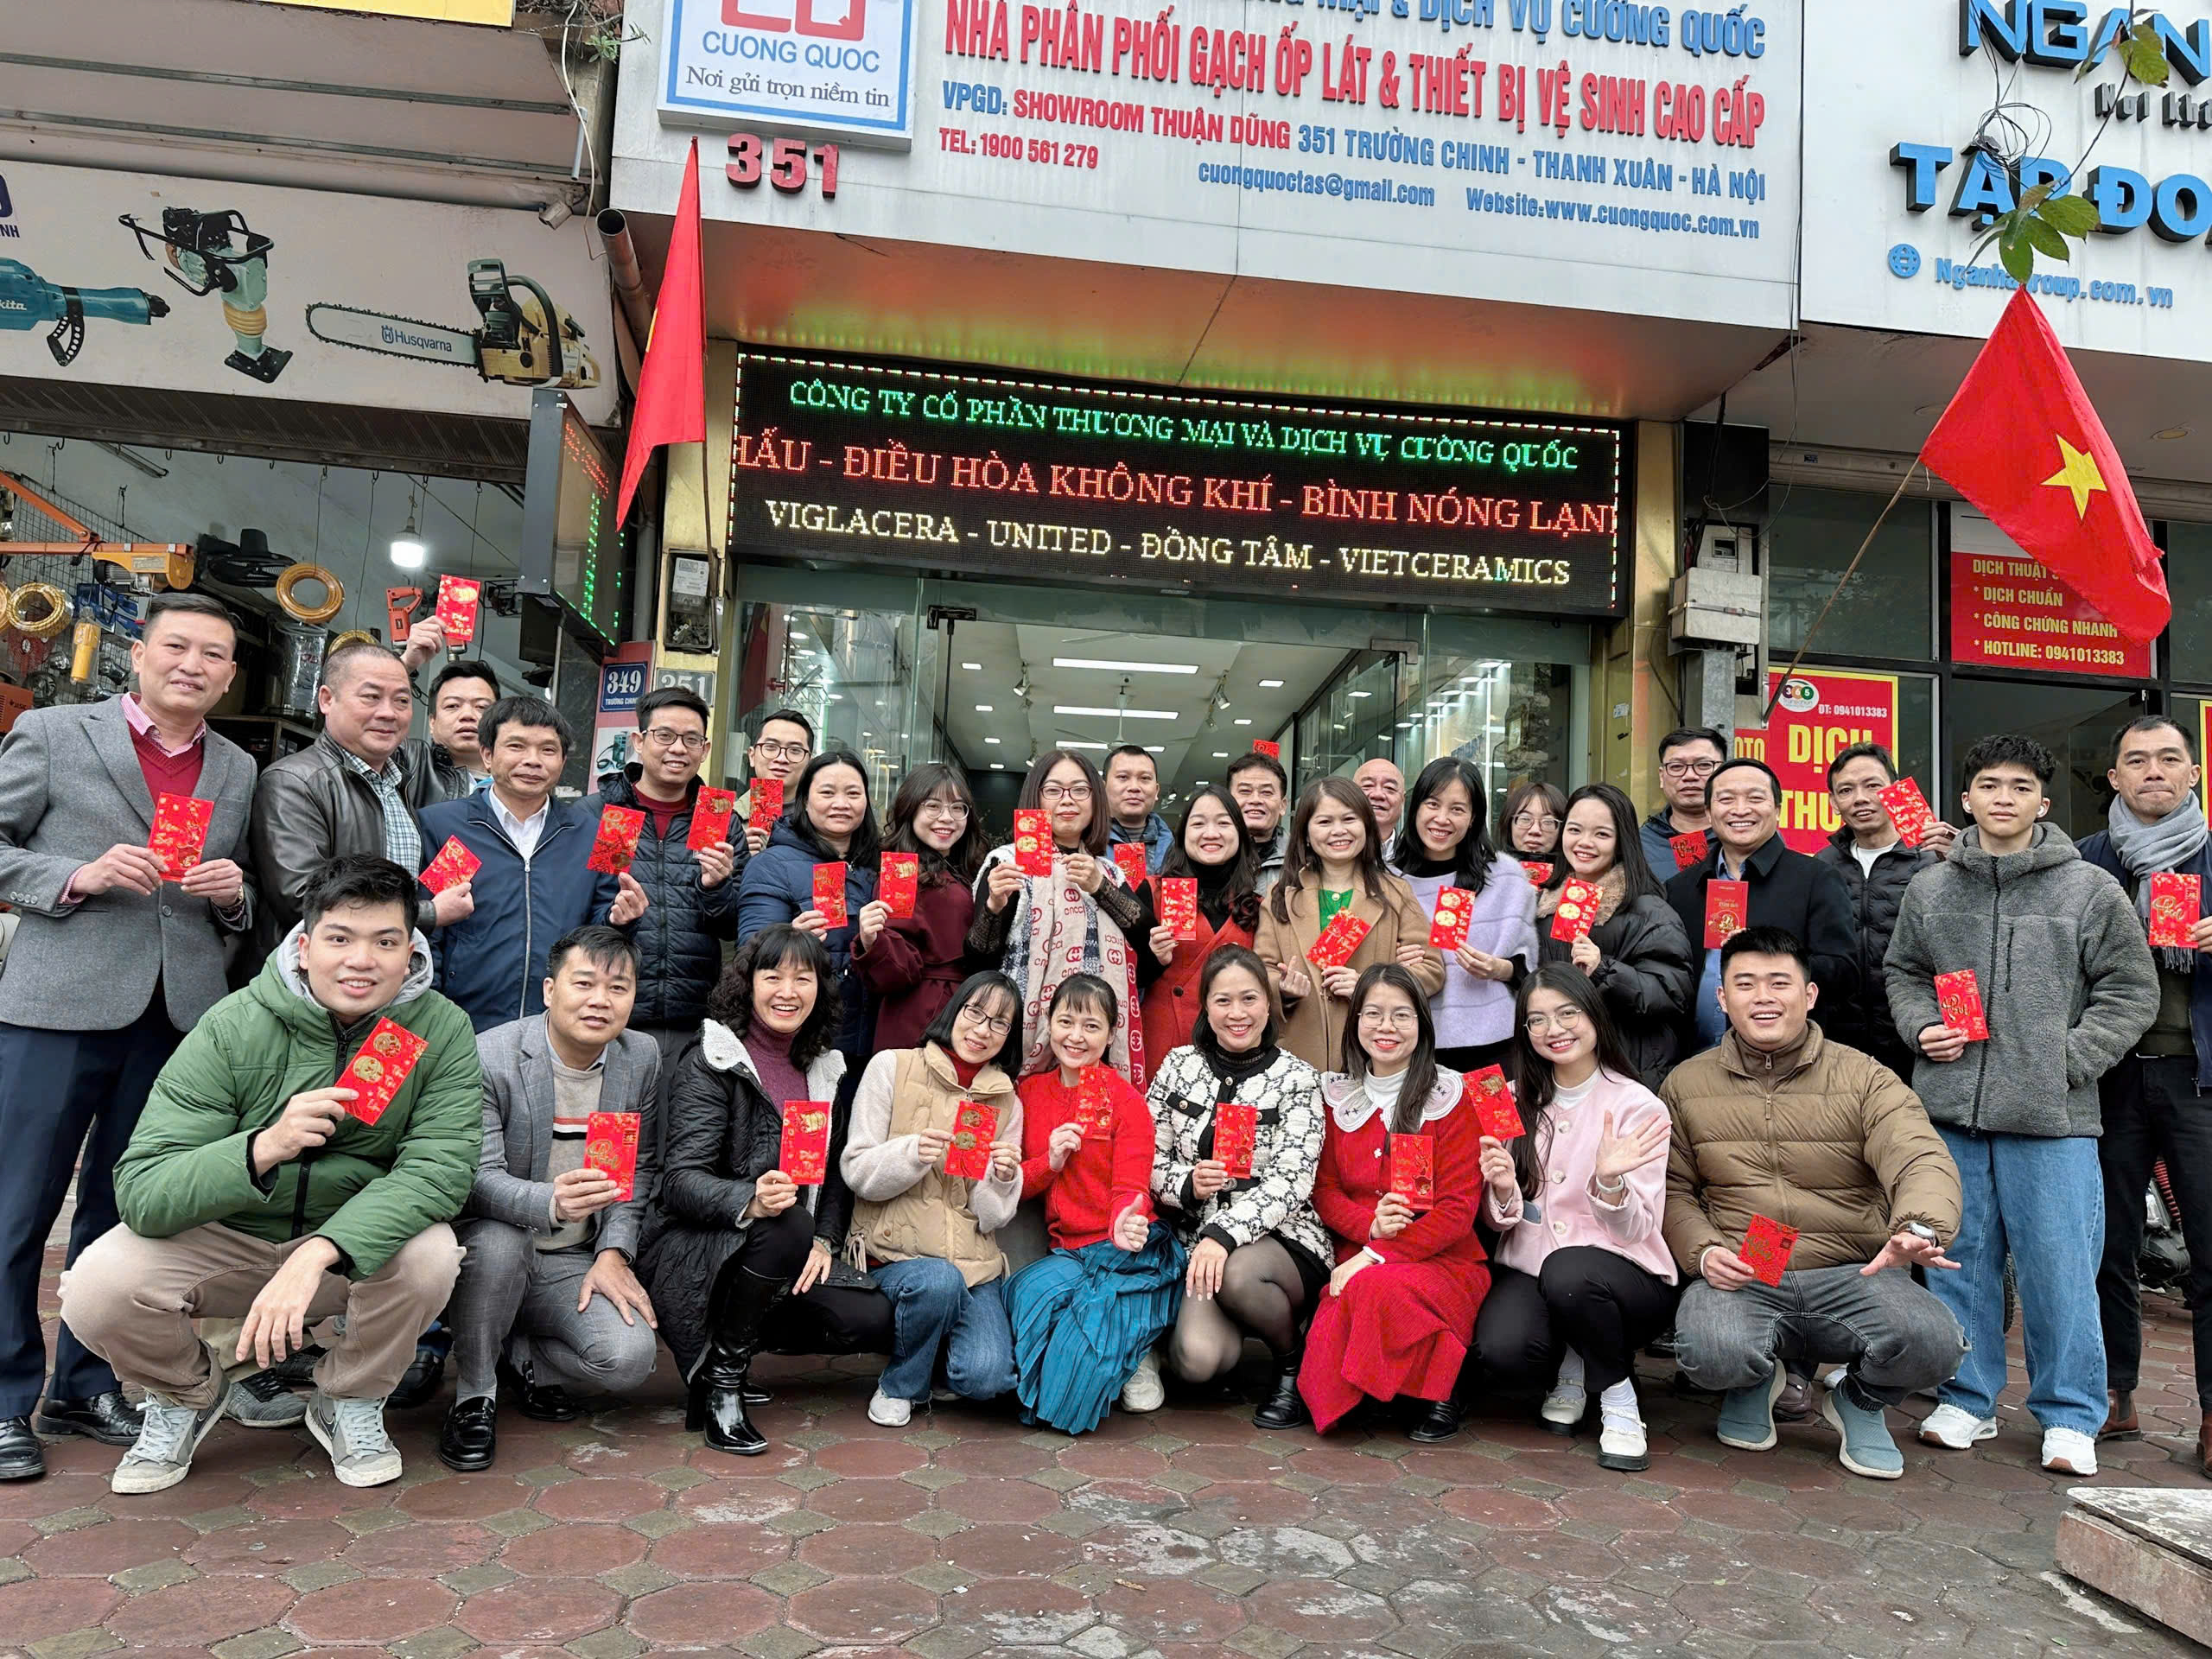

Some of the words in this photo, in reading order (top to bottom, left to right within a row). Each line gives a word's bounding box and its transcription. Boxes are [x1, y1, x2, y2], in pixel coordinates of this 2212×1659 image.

[1511, 0, 1551, 44] VỤ
[1681, 3, 1764, 58] QUỐC
[702, 31, 797, 63] CUONG
[805, 44, 880, 73] QUOC
[685, 66, 723, 87] Nơi
[730, 73, 760, 94] gửi
[767, 78, 804, 100] trọn
[810, 82, 858, 103] niềm
[865, 87, 890, 107] tin
[1020, 0, 1104, 73] PHÂN
[1112, 5, 1180, 83] PHỐI
[1189, 26, 1266, 98] GẠCH
[1275, 21, 1313, 97] ỐP
[1322, 34, 1372, 105] LÁT
[1379, 51, 1400, 109] &
[1408, 43, 1486, 118] THIẾT
[1498, 64, 1526, 134] BỊ
[1537, 60, 1570, 138] VỆ
[1580, 73, 1646, 137] SINH
[1655, 81, 1705, 143] CAO
[1712, 75, 1765, 148] CẤP
[939, 127, 976, 155] TEL:
[980, 133, 1022, 159] 1900
[1028, 139, 1058, 164] 561
[1064, 143, 1098, 168] 279
[943, 80, 1007, 116] VPGD:
[1014, 89, 1144, 132] SHOWROOM
[1151, 106, 1224, 145] THUẬN
[1230, 113, 1291, 149] DŨNG
[1299, 124, 1335, 154] 351
[1345, 126, 1434, 166] TRƯỜNG
[1441, 140, 1510, 174] CHINH
[1533, 150, 1606, 183] THANH
[1613, 157, 1672, 191] XUÂN
[1692, 163, 1721, 196] HÀ
[1729, 168, 1765, 205] NỘI
[725, 132, 839, 200] 351
[1198, 162, 1434, 207] cuongquoctas@gmail.com
[395, 329, 452, 353] Husqvarna
[790, 378, 870, 412] CÔNG
[878, 390, 917, 415] TY
[923, 389, 958, 421] CỔ
[1180, 418, 1235, 448] MẠI
[1240, 420, 1274, 448] VÀ
[1281, 424, 1348, 455] DỊCH
[1354, 433, 1392, 461] VỤ
[1503, 439, 1578, 472] QUỐC
[843, 438, 942, 485] ĐIỀU
[951, 450, 1039, 493] HÒA
[1049, 461, 1192, 505] KHÔNG
[1203, 474, 1273, 512] KHÍ
[1302, 479, 1397, 521] BÌNH
[1408, 486, 1520, 528] NÓNG
[766, 499, 959, 543] VIGLACERA
[986, 519, 1111, 556] UNITED
[1141, 525, 1233, 565] ĐỒNG
[1242, 535, 1313, 569] TÂM
[1339, 547, 1570, 586] VIETCERAMICS
[1973, 558, 2004, 576] DỊCH
[1984, 586, 2014, 604] DỊCH
[2018, 587, 2063, 607] CHUẨN
[1984, 611, 2019, 630] CÔNG
[2024, 614, 2069, 634] CHỨNG
[2073, 620, 2118, 639] NHANH
[1984, 640, 2042, 658] HOTLINE:
[2045, 645, 2125, 665] 0941013383
[607, 670, 642, 695] 349
[1834, 705, 1888, 718] 0941013383
